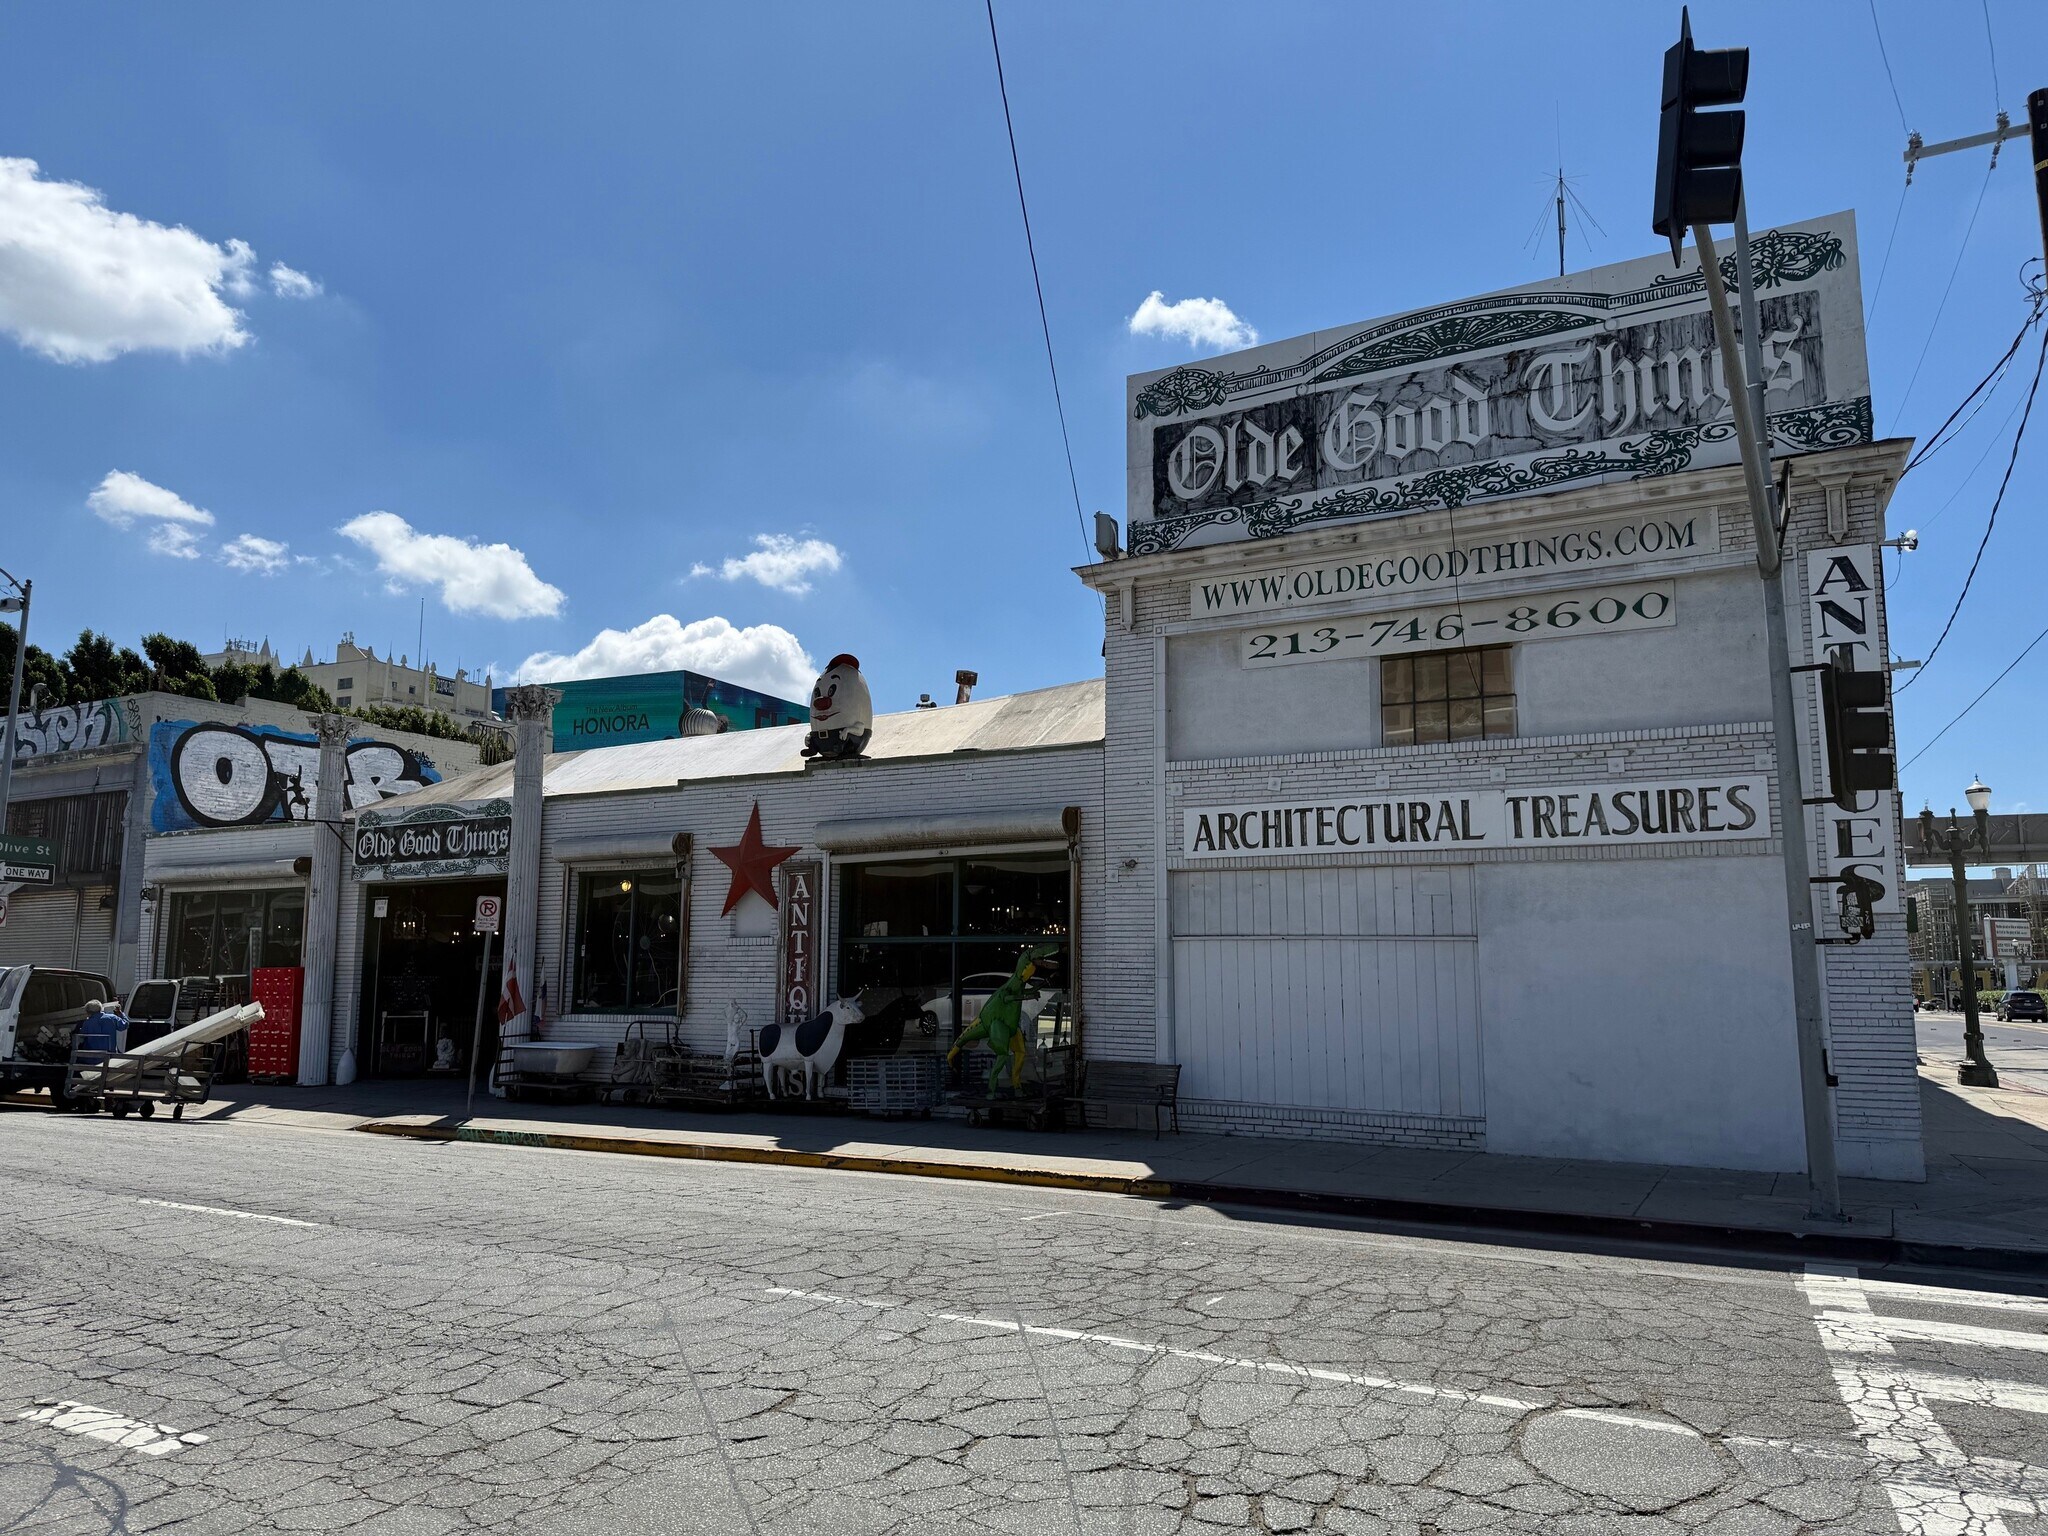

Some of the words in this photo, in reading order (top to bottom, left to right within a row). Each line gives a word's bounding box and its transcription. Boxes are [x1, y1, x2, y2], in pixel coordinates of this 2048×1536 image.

[1167, 421, 1304, 500] Olde
[1323, 376, 1492, 472] Good
[1201, 517, 1698, 611] WWW.OLDEGOODTHINGS.COM
[1248, 592, 1670, 661] 213-746-8600
[573, 713, 650, 735] HONORA
[36, 845, 50, 856] St
[358, 831, 396, 859] Olde
[399, 828, 441, 856] Good
[447, 823, 509, 858] Things
[1192, 799, 1487, 852] ARCHITECTURAL
[1505, 784, 1758, 840] TREASURES
[5, 867, 25, 877] ONE
[28, 869, 47, 878] WAY
[788, 875, 812, 1097] ANTIQS
